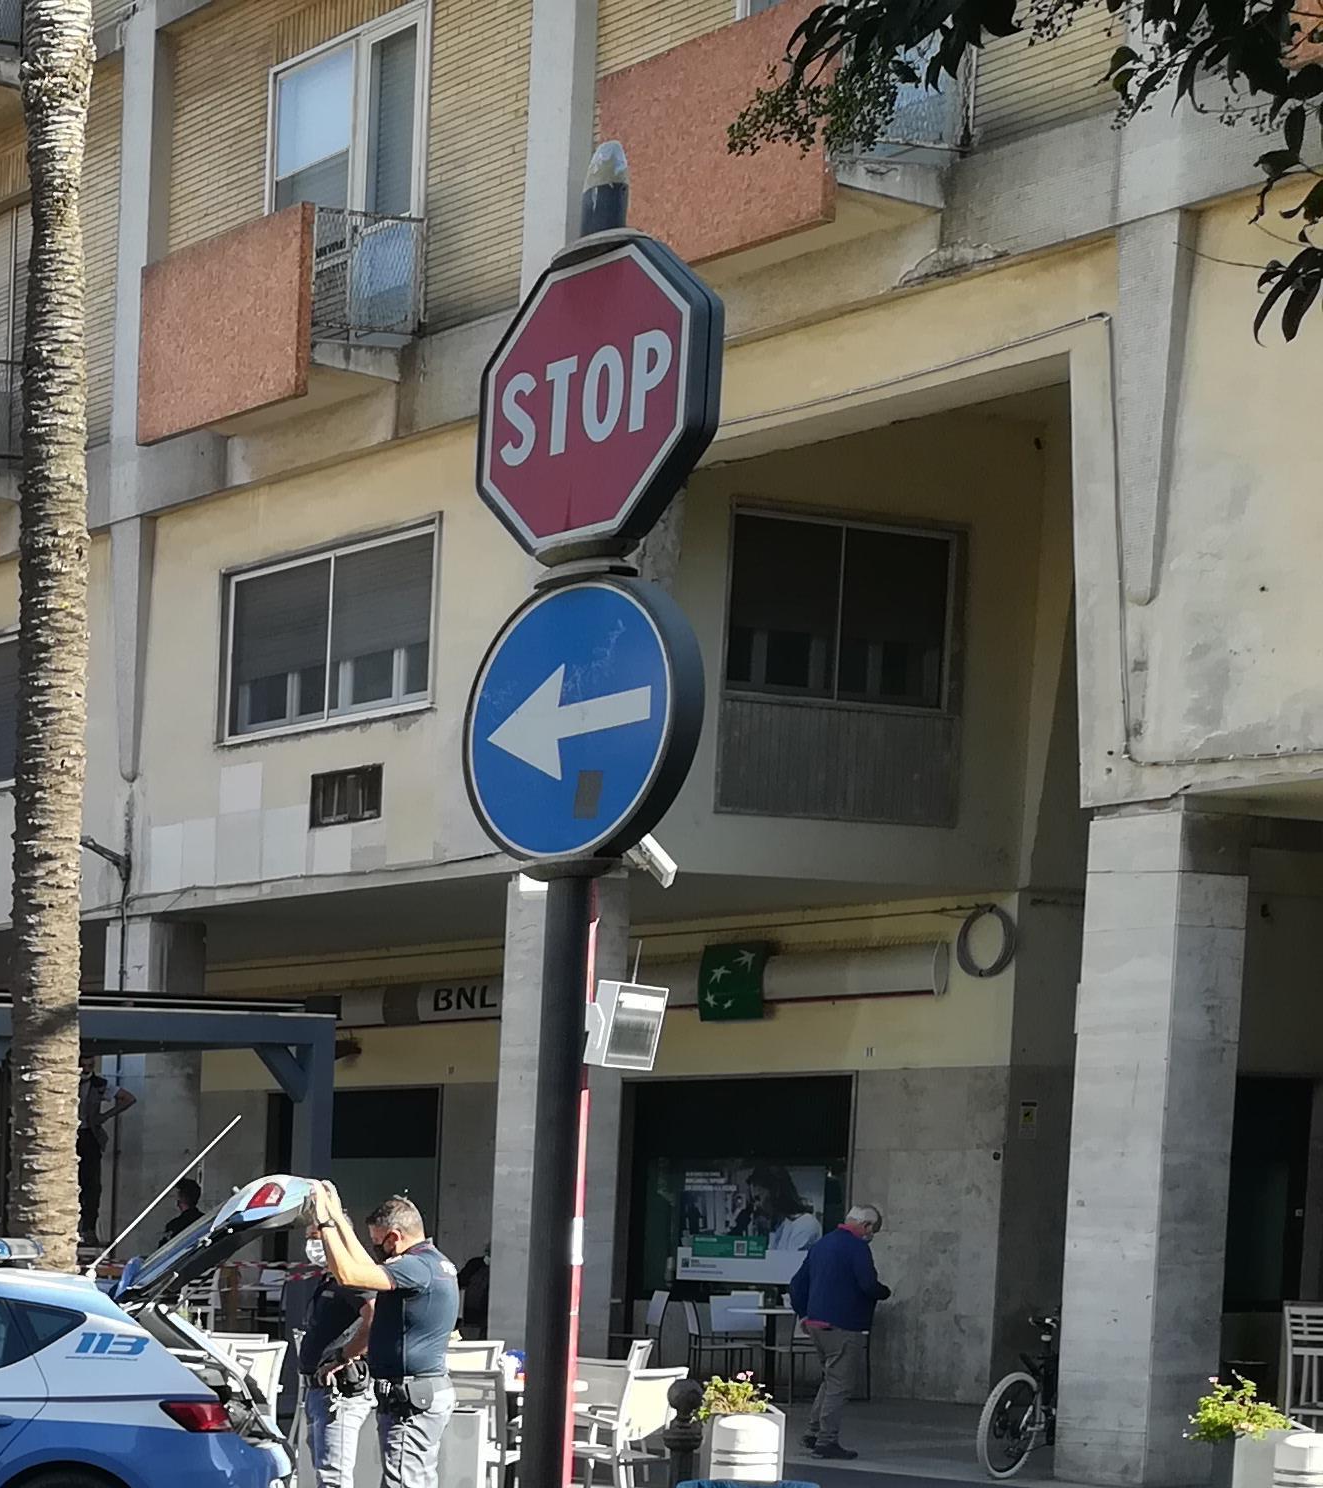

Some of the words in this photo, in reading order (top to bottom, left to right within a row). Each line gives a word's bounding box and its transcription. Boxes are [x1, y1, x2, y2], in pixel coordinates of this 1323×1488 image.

[499, 328, 674, 468] STOP
[433, 985, 498, 1013] BNL
[74, 1331, 151, 1357] 113
